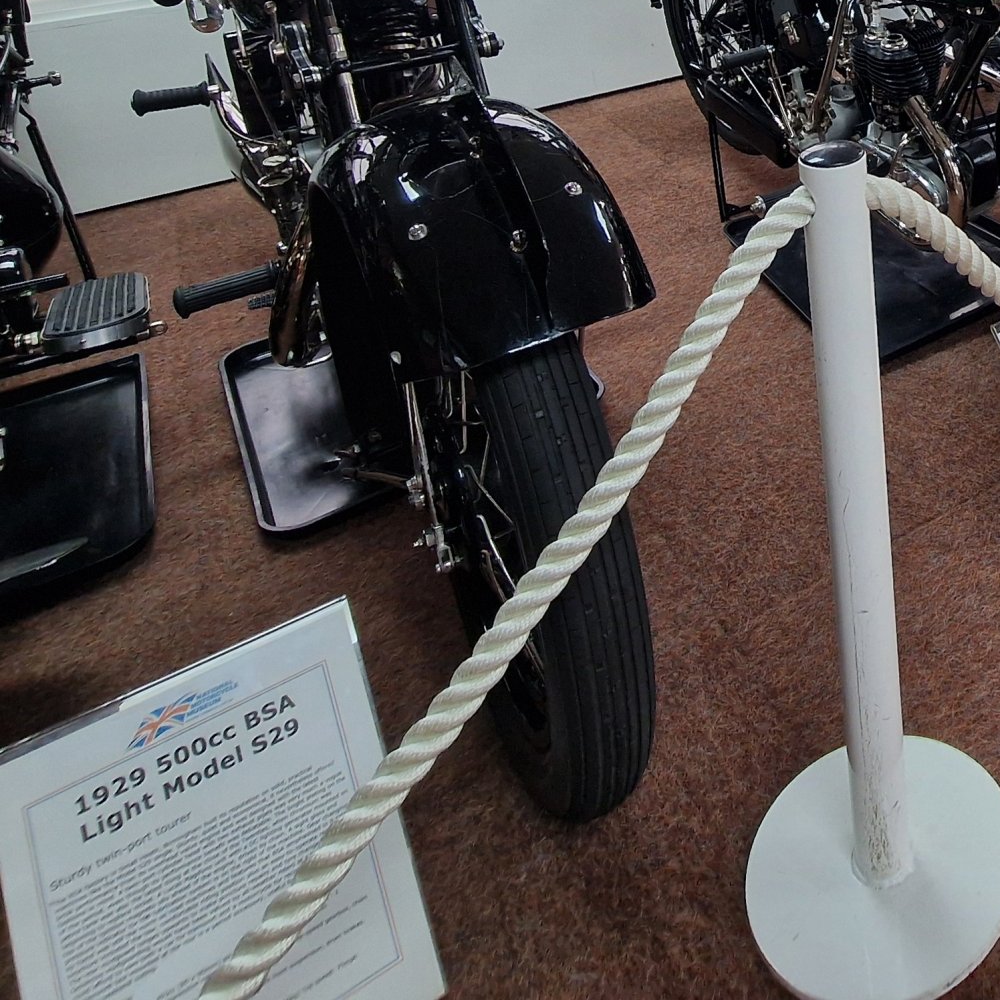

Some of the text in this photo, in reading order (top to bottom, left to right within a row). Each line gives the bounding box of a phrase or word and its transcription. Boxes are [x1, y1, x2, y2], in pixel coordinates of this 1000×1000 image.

[74, 767, 147, 815] 1929
[157, 725, 237, 775] 500cc
[244, 694, 297, 731] BSA
[79, 717, 300, 844] Light Model S29
[49, 810, 193, 892] Sturdy twin-port tourer
